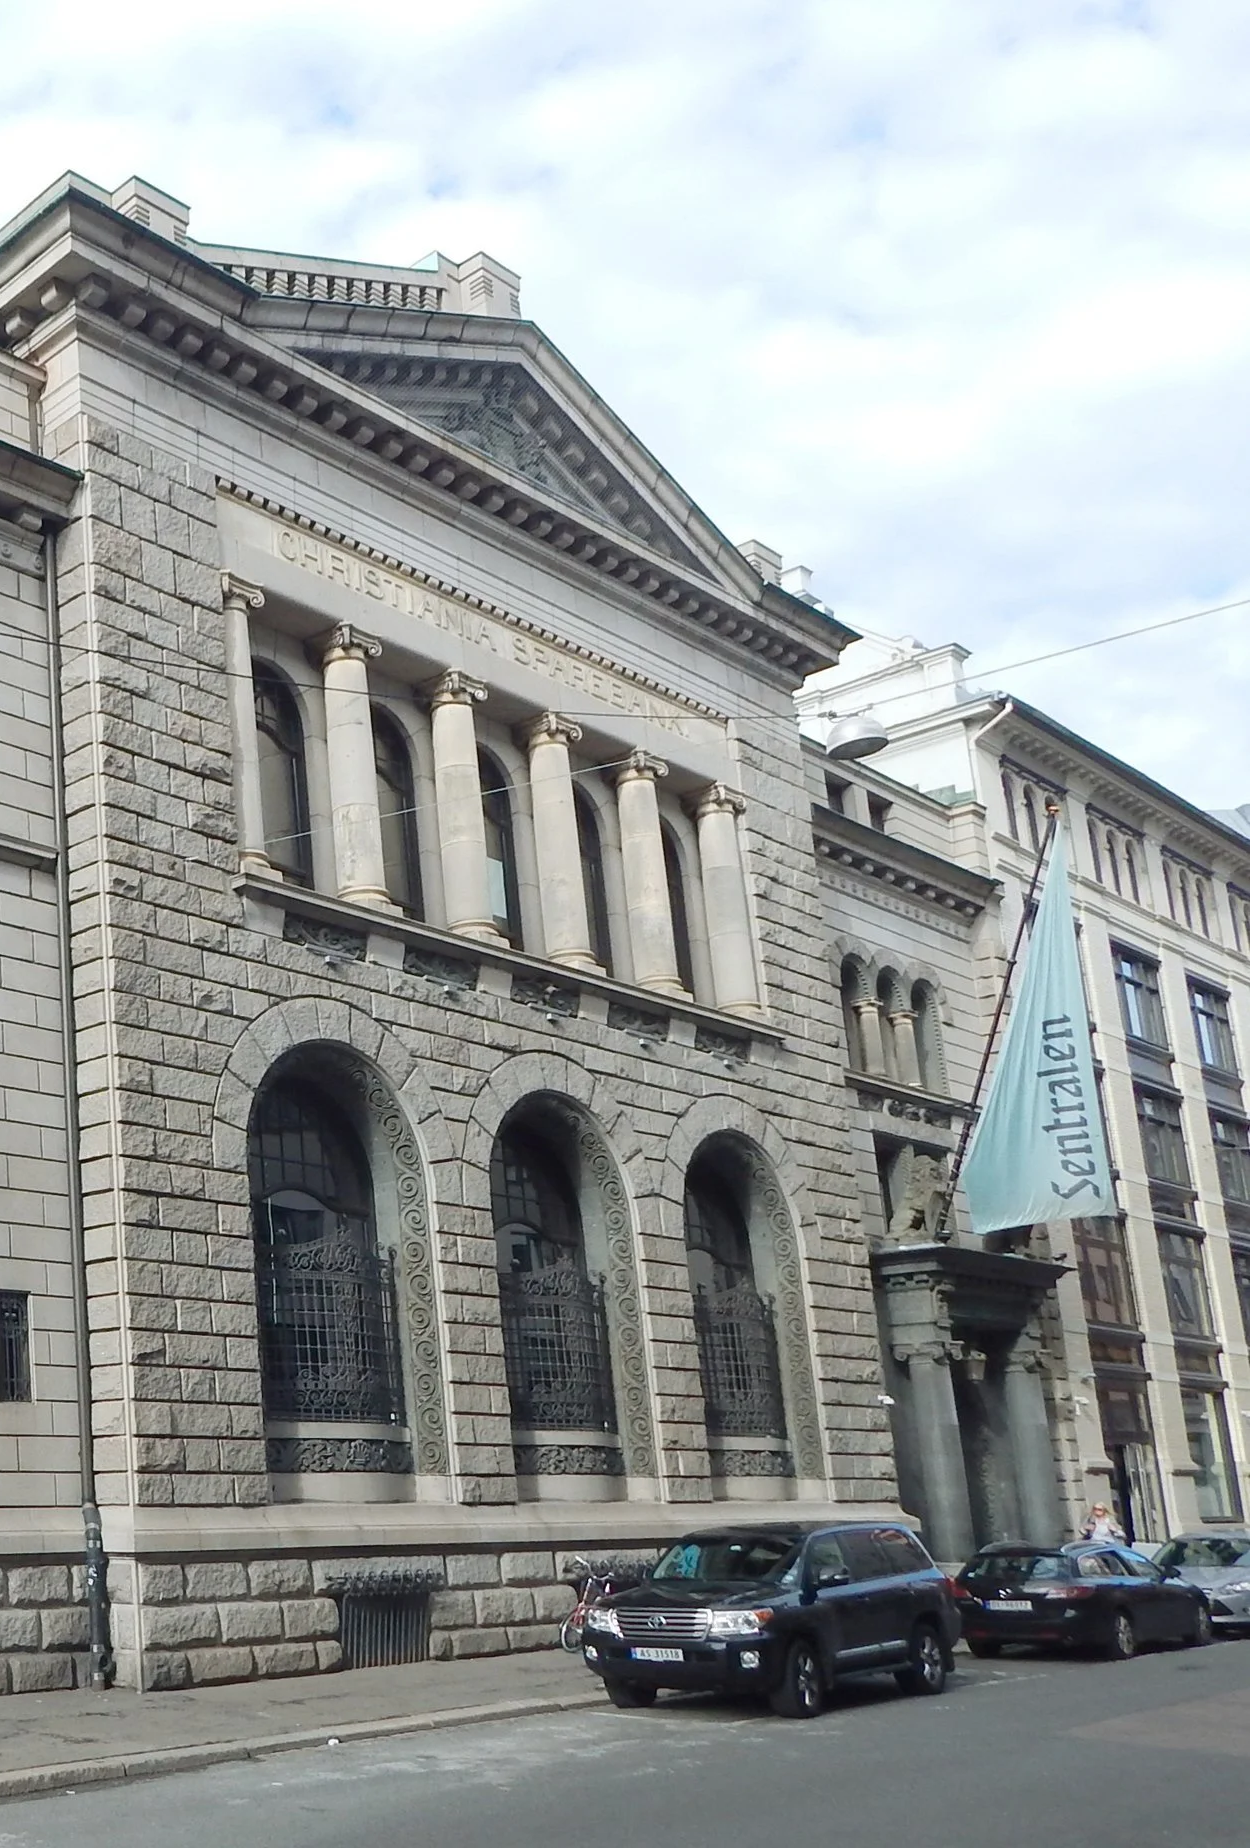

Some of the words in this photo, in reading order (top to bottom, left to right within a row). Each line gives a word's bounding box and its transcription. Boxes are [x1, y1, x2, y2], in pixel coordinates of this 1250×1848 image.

[277, 529, 498, 652] CHRISTIANIA
[512, 637, 690, 738] SPAREBANK
[1037, 1014, 1101, 1199] Sentralen
